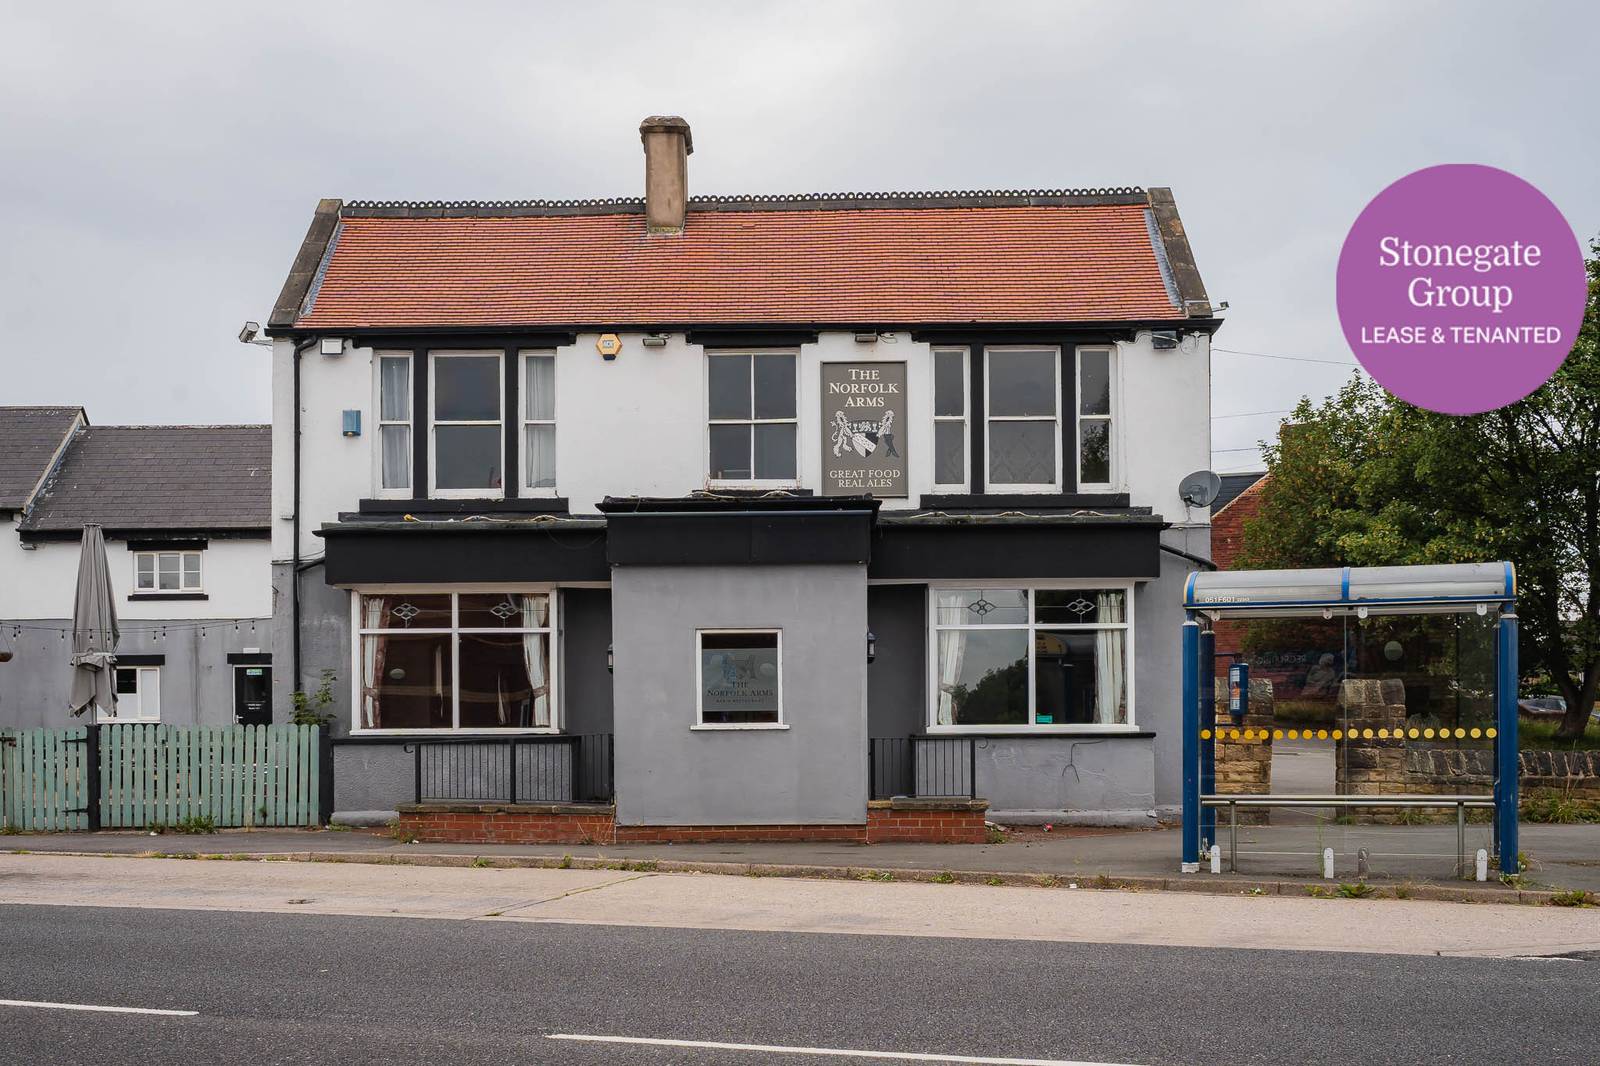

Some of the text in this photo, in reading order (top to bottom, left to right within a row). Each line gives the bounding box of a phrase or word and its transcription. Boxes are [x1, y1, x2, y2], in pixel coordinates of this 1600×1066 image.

[848, 369, 880, 380] THE
[829, 383, 900, 394] NORFOLK
[845, 396, 885, 407] ARMS
[829, 469, 900, 479] GREAT FOOD
[838, 479, 892, 488] REAL ALES
[707, 688, 774, 697] NORFOLK ARMS
